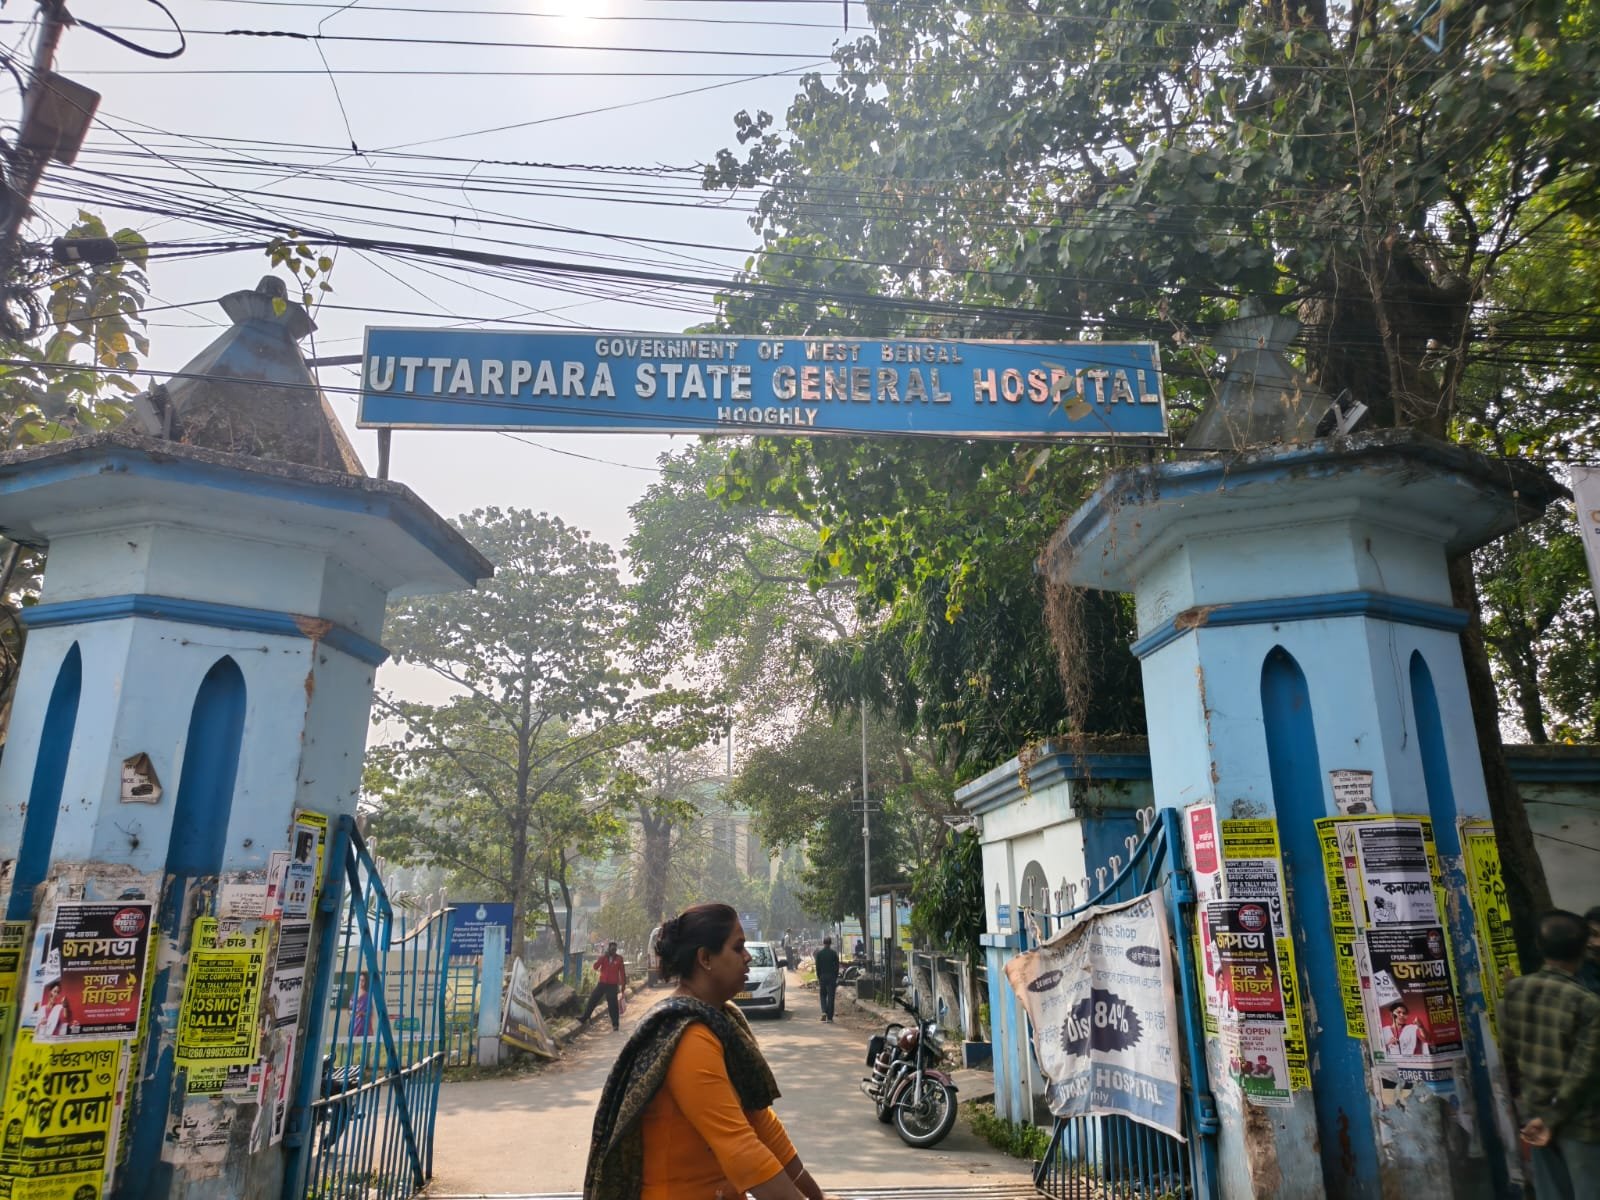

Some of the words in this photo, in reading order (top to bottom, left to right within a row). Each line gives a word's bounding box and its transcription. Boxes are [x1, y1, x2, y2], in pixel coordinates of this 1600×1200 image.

[595, 338, 738, 360] GOVERNMENT
[758, 342, 784, 360] OF
[804, 341, 861, 362] WEST
[881, 343, 963, 364] BENGAL
[369, 356, 616, 398] UTTARPARA
[634, 363, 753, 400] STATE
[772, 365, 952, 402] GENERAL
[973, 367, 1159, 404] HOSPITAL
[717, 406, 819, 426] HOOGHLY
[62, 937, 138, 958] জনসভা
[83, 974, 120, 985] মশাল
[1231, 976, 1273, 994] মিছিল
[82, 985, 134, 1004] মিছিল
[192, 998, 240, 1012] COSMIC
[190, 1013, 237, 1026] BALLY
[1094, 1001, 1129, 1033] 84%
[1246, 1027, 1271, 1036] OPEN
[191, 1080, 223, 1089] 973511
[1096, 1068, 1162, 1105] HOSPITAL
[60, 1091, 112, 1128] মেলা
